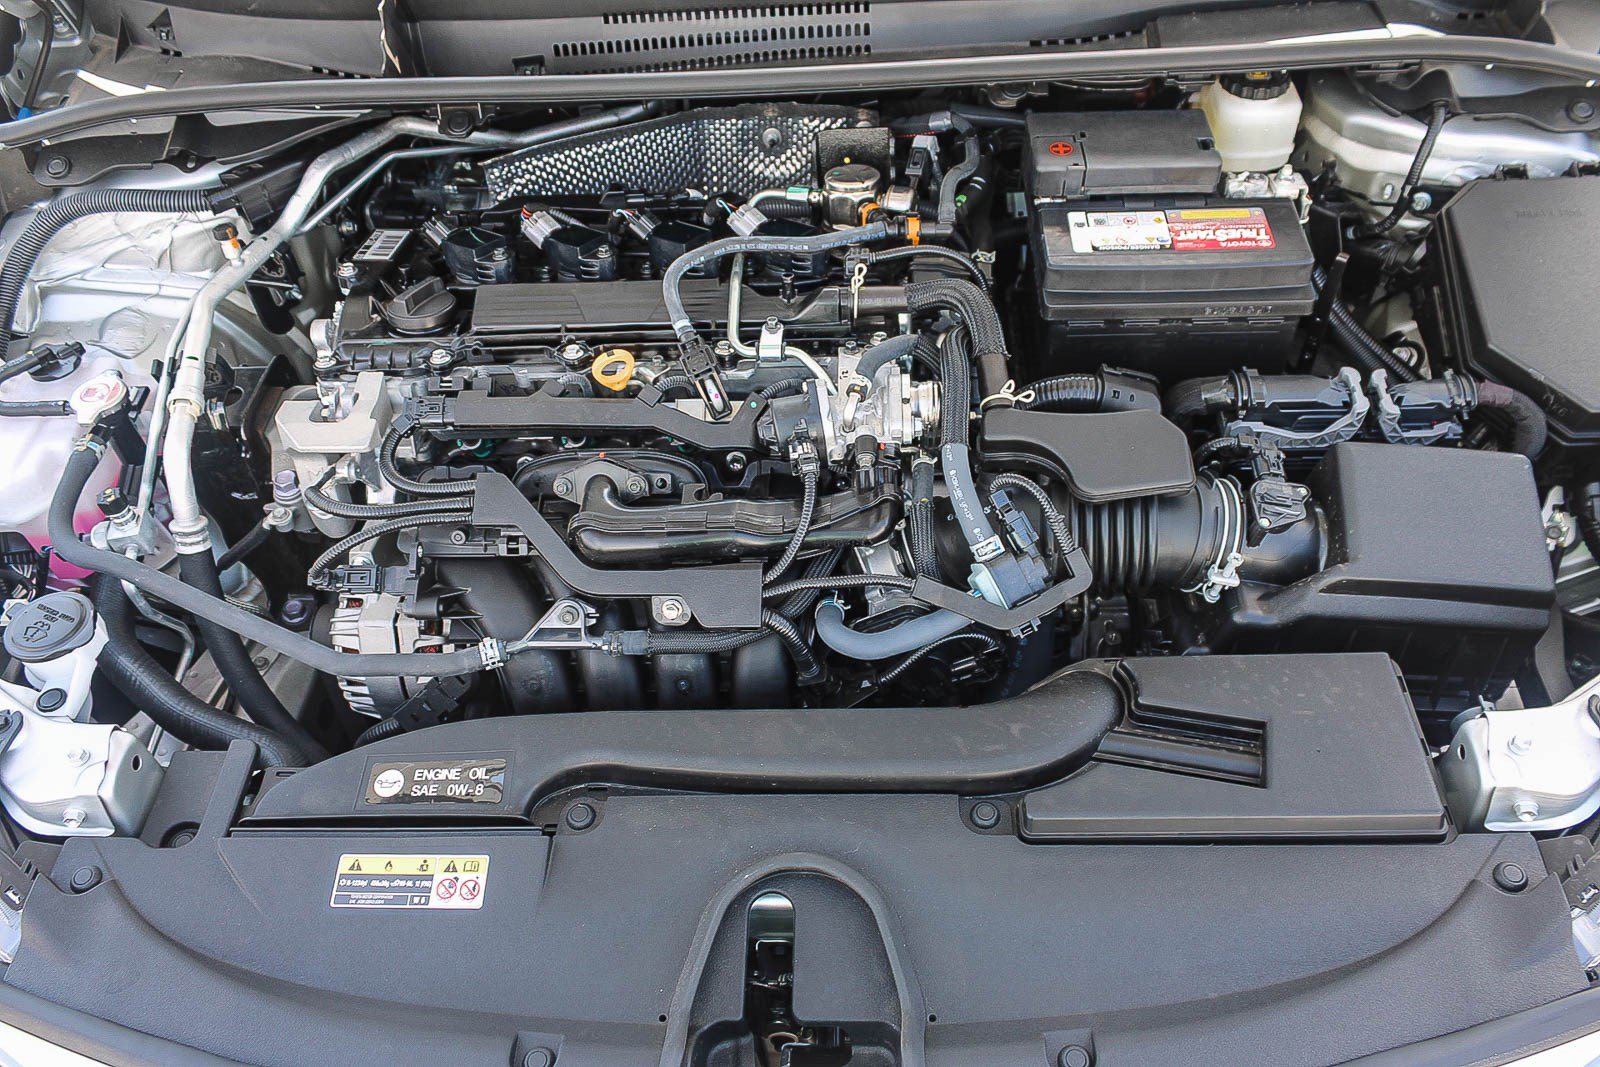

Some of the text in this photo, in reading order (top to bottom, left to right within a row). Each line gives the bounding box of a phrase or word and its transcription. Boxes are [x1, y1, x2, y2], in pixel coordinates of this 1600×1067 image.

[413, 767, 490, 781] ENGINE OIL
[411, 783, 484, 796] SAE 0W-8
